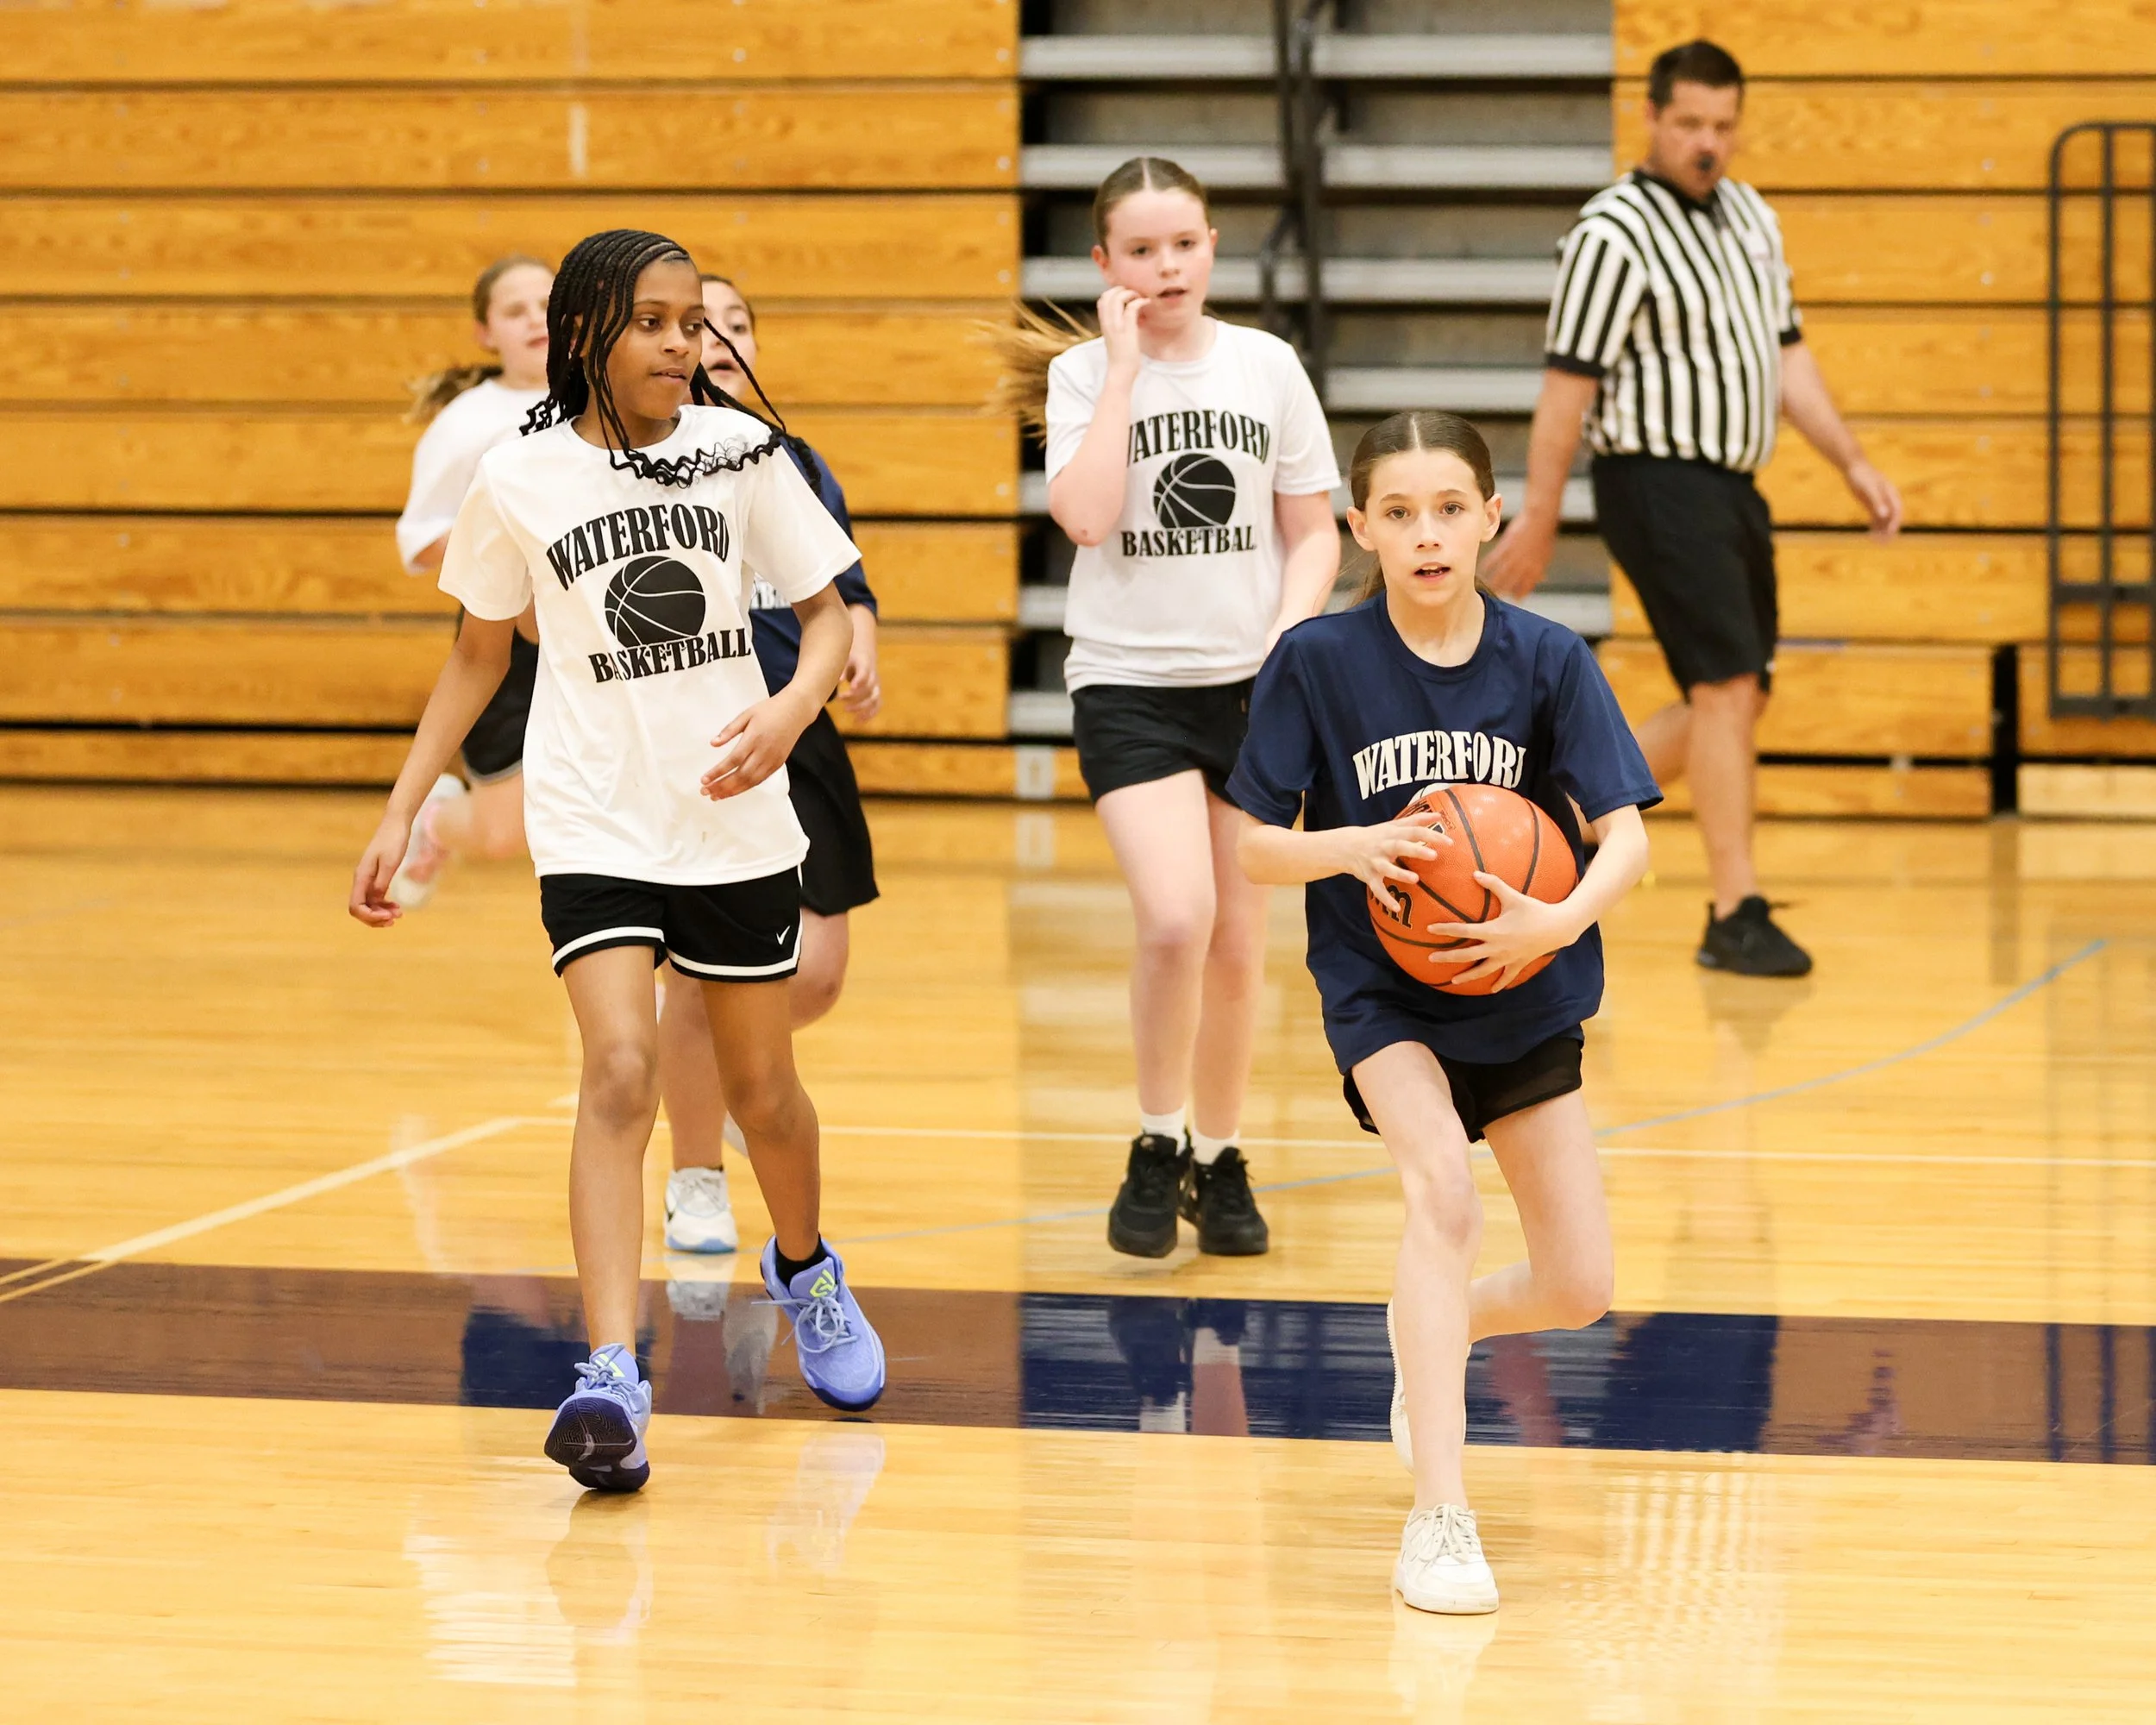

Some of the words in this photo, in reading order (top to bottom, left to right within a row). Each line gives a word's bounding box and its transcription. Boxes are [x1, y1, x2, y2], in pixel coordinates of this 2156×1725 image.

[1126, 409, 1269, 467] ATERFORD
[546, 503, 730, 591] WATERFORD
[1121, 525, 1257, 557] BASKETBAL
[588, 628, 751, 683] BASKETBALL
